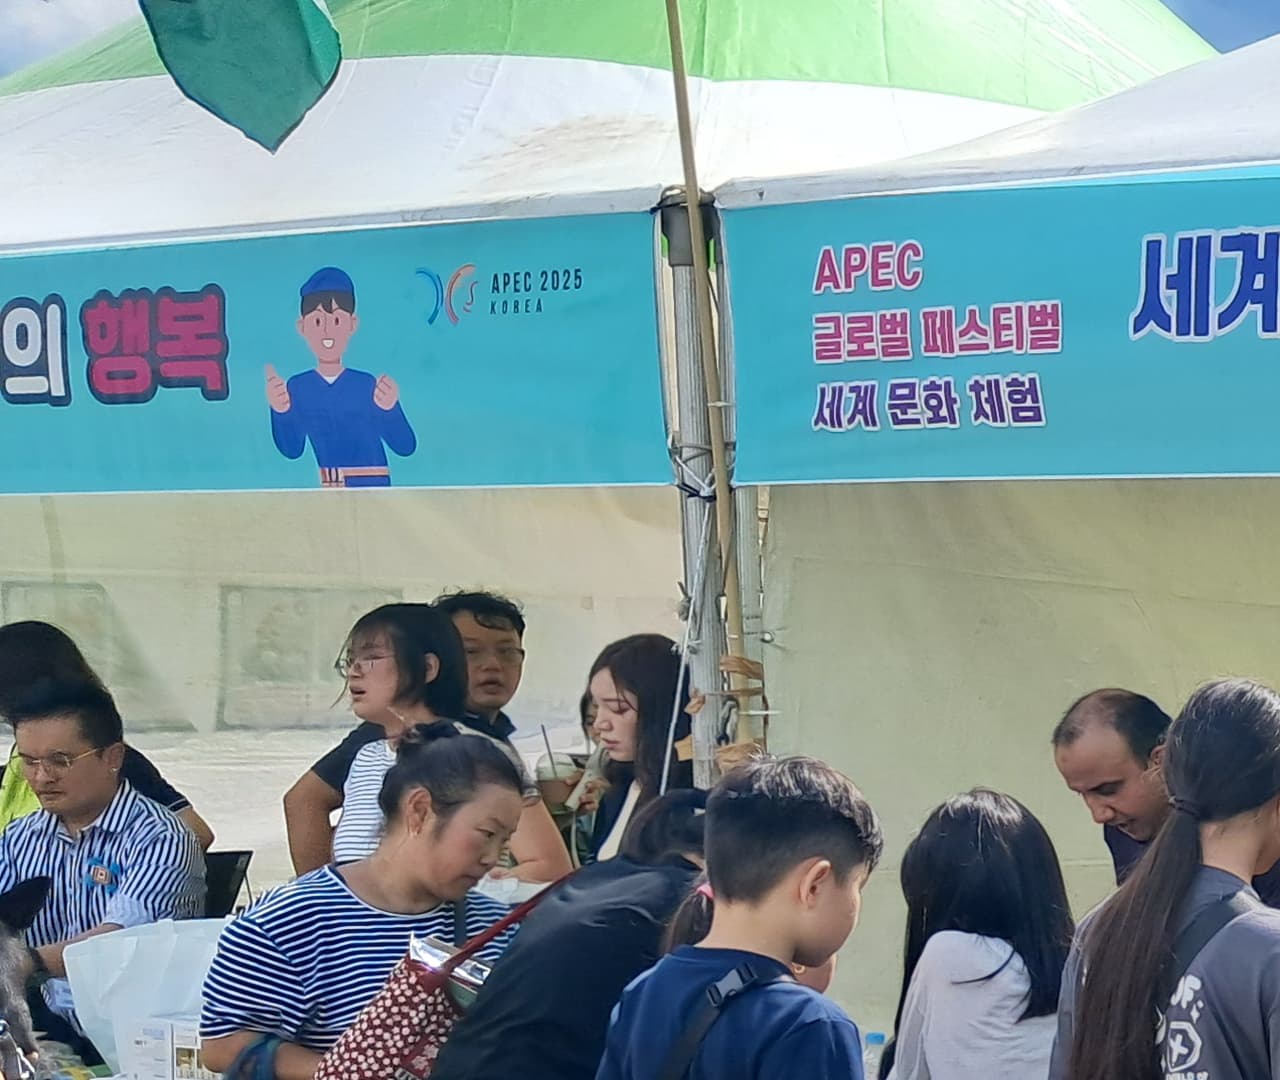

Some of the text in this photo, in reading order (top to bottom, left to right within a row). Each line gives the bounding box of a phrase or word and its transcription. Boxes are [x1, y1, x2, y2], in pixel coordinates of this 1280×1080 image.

[490, 267, 584, 295] APEC 2025
[814, 241, 924, 294] APEC
[489, 297, 545, 315] KOREA
[813, 301, 1062, 363] 글로벌 페스티벌
[1, 286, 227, 402] 의 행복
[812, 372, 1046, 431] 세계 문화 체험
